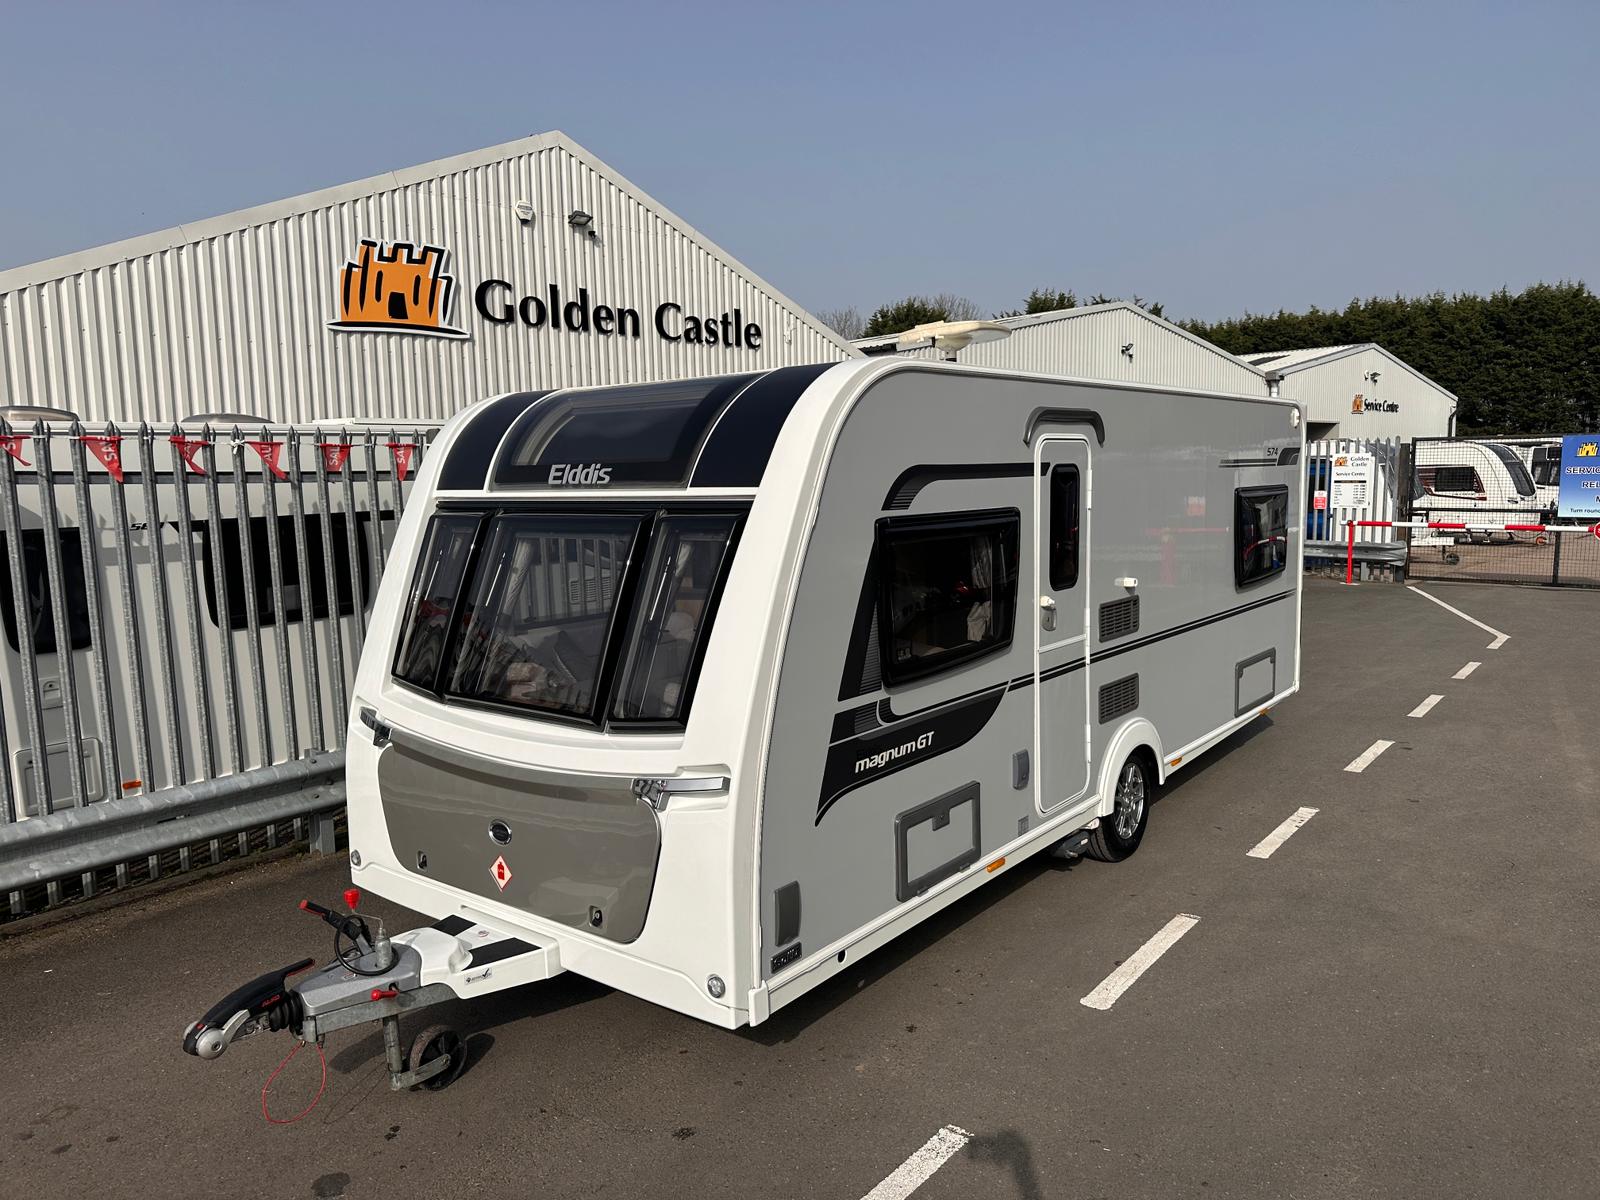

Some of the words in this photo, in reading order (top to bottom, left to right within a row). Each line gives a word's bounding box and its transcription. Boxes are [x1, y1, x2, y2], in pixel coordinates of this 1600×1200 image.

[475, 278, 641, 338] Golden
[655, 302, 762, 351] Castle
[1364, 398, 1382, 412] Service
[1382, 399, 1400, 413] Centre
[329, 445, 340, 466] SAL
[1266, 447, 1279, 457] 574
[548, 463, 613, 485] Elddis
